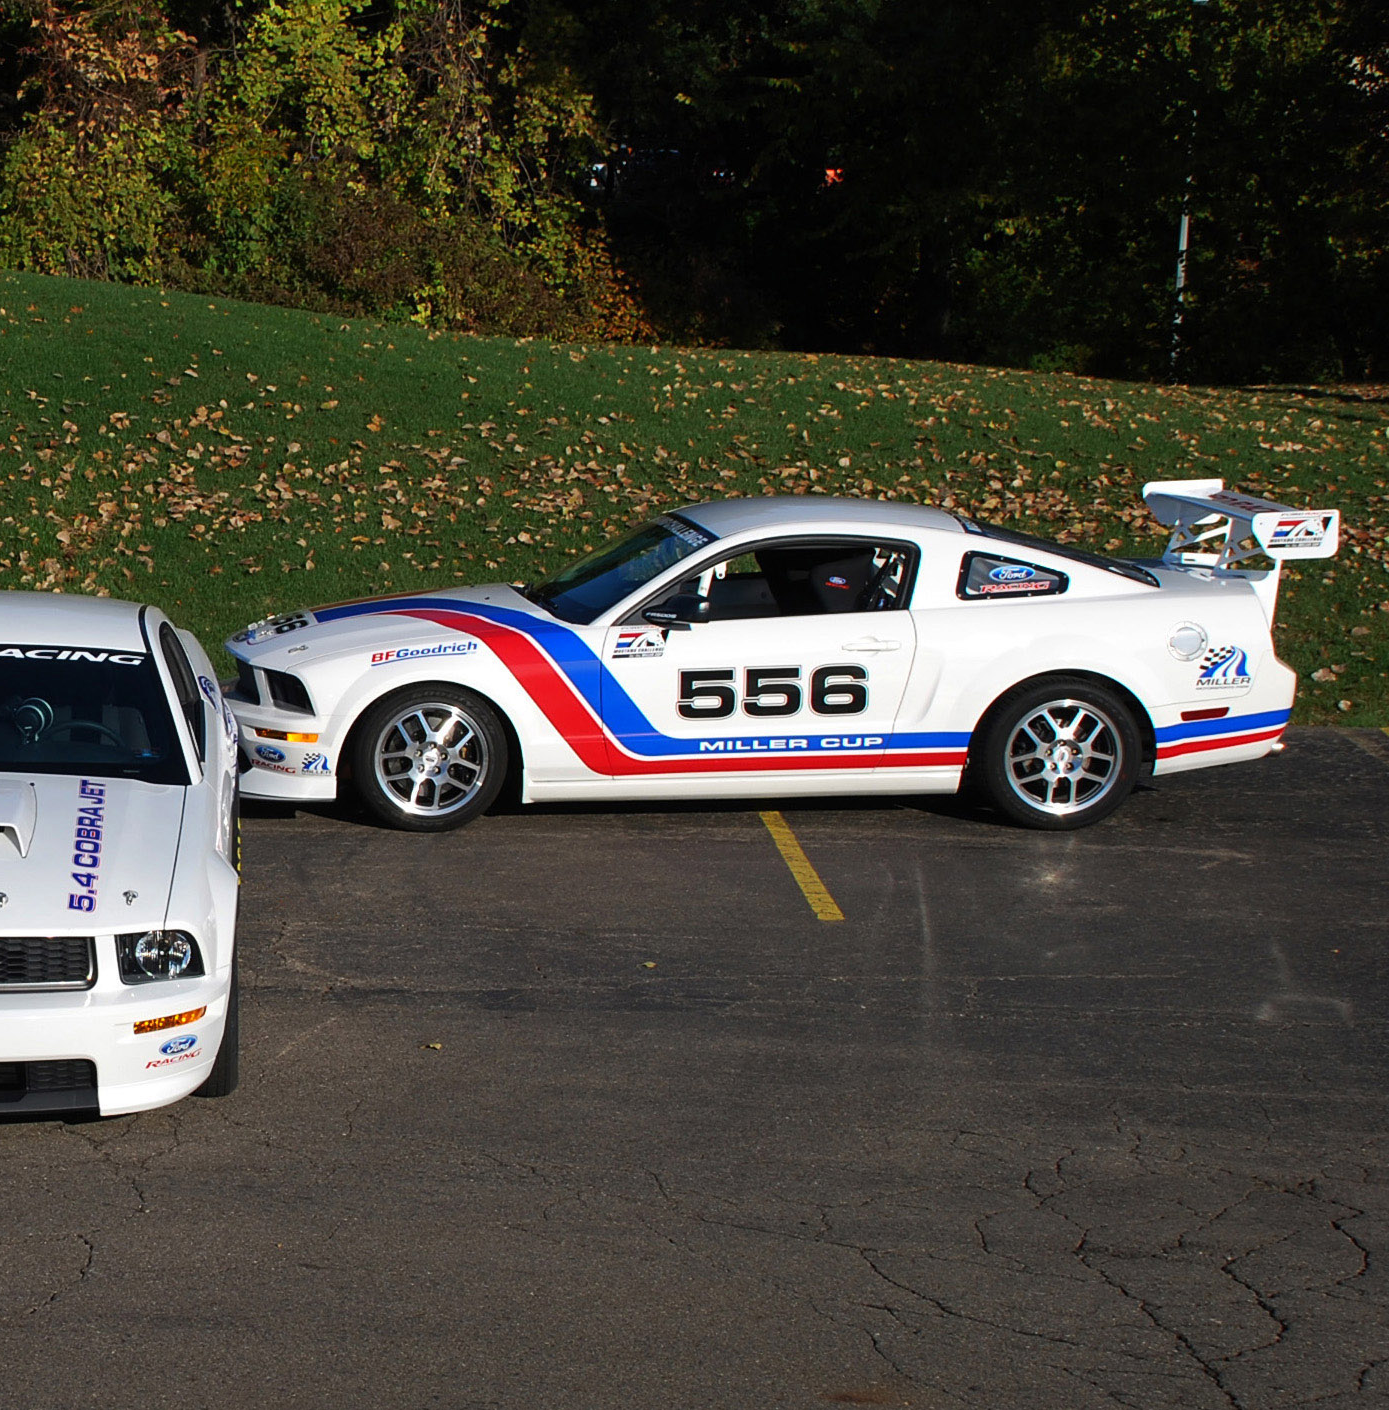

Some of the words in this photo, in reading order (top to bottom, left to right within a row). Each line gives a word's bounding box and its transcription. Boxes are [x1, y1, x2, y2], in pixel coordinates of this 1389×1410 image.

[979, 580, 1051, 594] RACING
[371, 641, 478, 663] BFGoodrich
[677, 664, 869, 720] 556
[1196, 676, 1252, 687] MILLER
[699, 738, 809, 752] MILLER
[820, 737, 884, 749] CUP
[252, 759, 297, 775] RACING
[78, 779, 107, 805] JET
[72, 806, 106, 868] COBRA
[67, 872, 99, 913] 5.4
[145, 1047, 203, 1069] RACING
